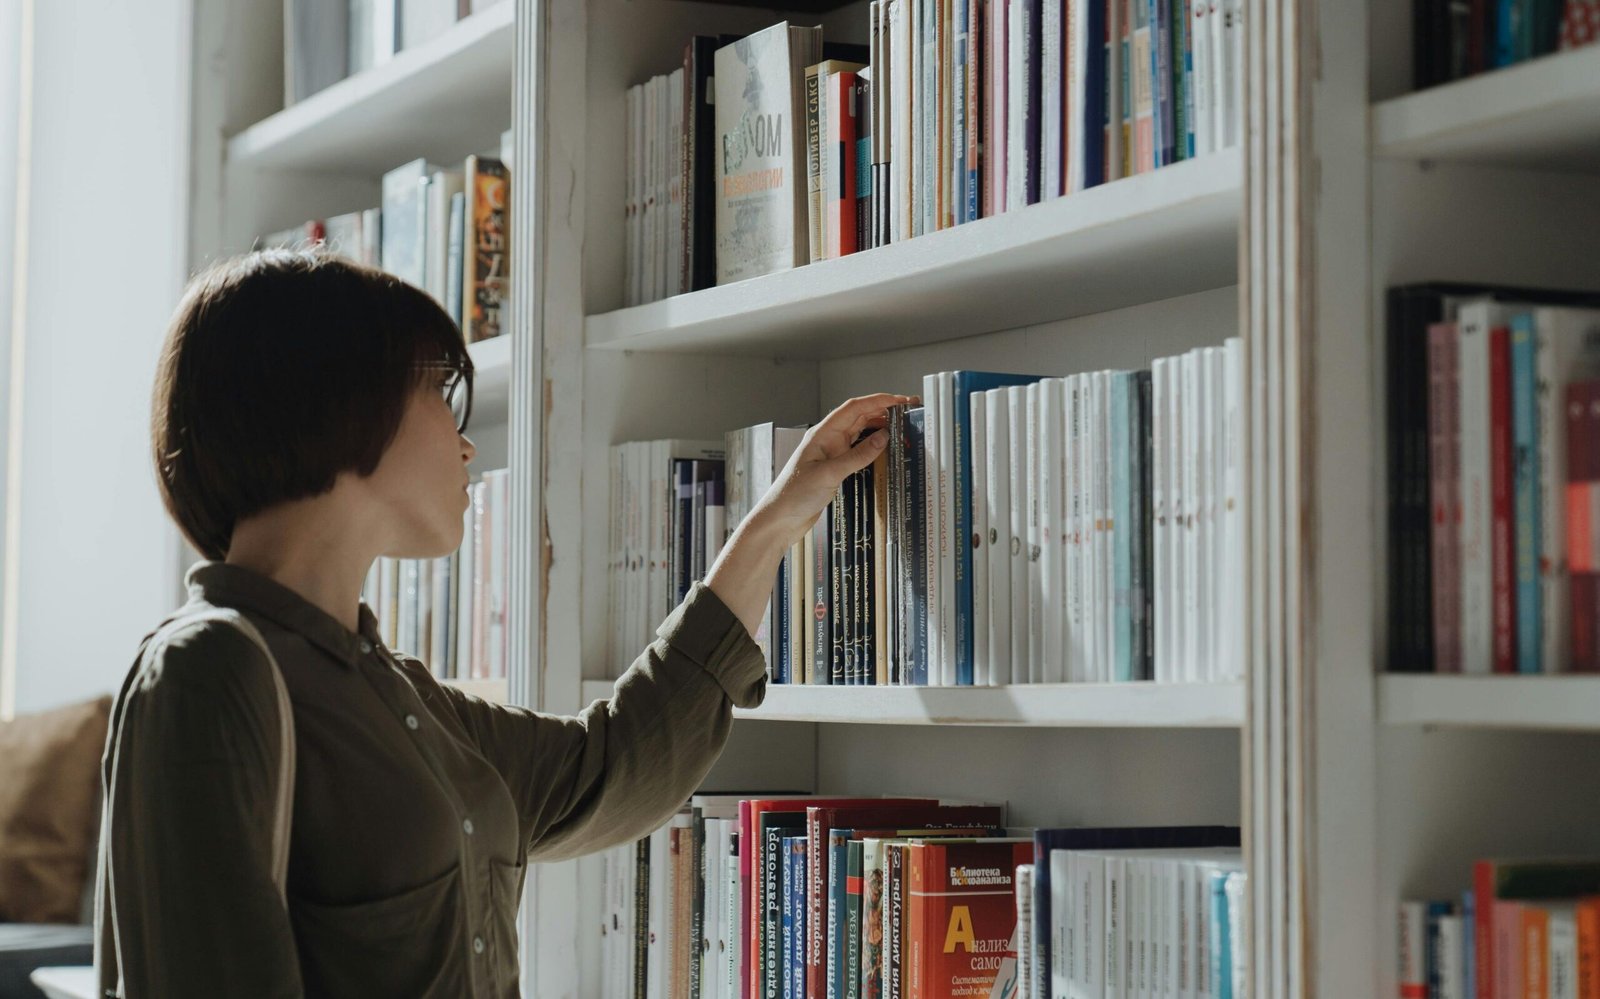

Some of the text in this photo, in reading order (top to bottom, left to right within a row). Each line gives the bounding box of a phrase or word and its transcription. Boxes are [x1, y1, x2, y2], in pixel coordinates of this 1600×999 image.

[808, 80, 819, 171] ОЛИВЕР САКС
[904, 470, 912, 488] тела
[954, 423, 963, 581] ИСТОКИ ПСИХОТЕРАПИИ
[904, 491, 913, 521] Театры
[927, 499, 936, 615] ИНДИВИДУАЛЬНАЯ
[813, 587, 827, 620] Фрейд
[815, 621, 825, 656] Зигмунд
[783, 845, 791, 916] ДИСКУРС
[813, 819, 823, 967] теории и практики
[950, 867, 1001, 878] Библиотека
[952, 875, 1011, 887] психоанализа
[766, 833, 779, 999] едневный разговор
[892, 879, 901, 965] диктатуры
[943, 905, 1009, 954] Анализ
[970, 957, 1002, 970] само
